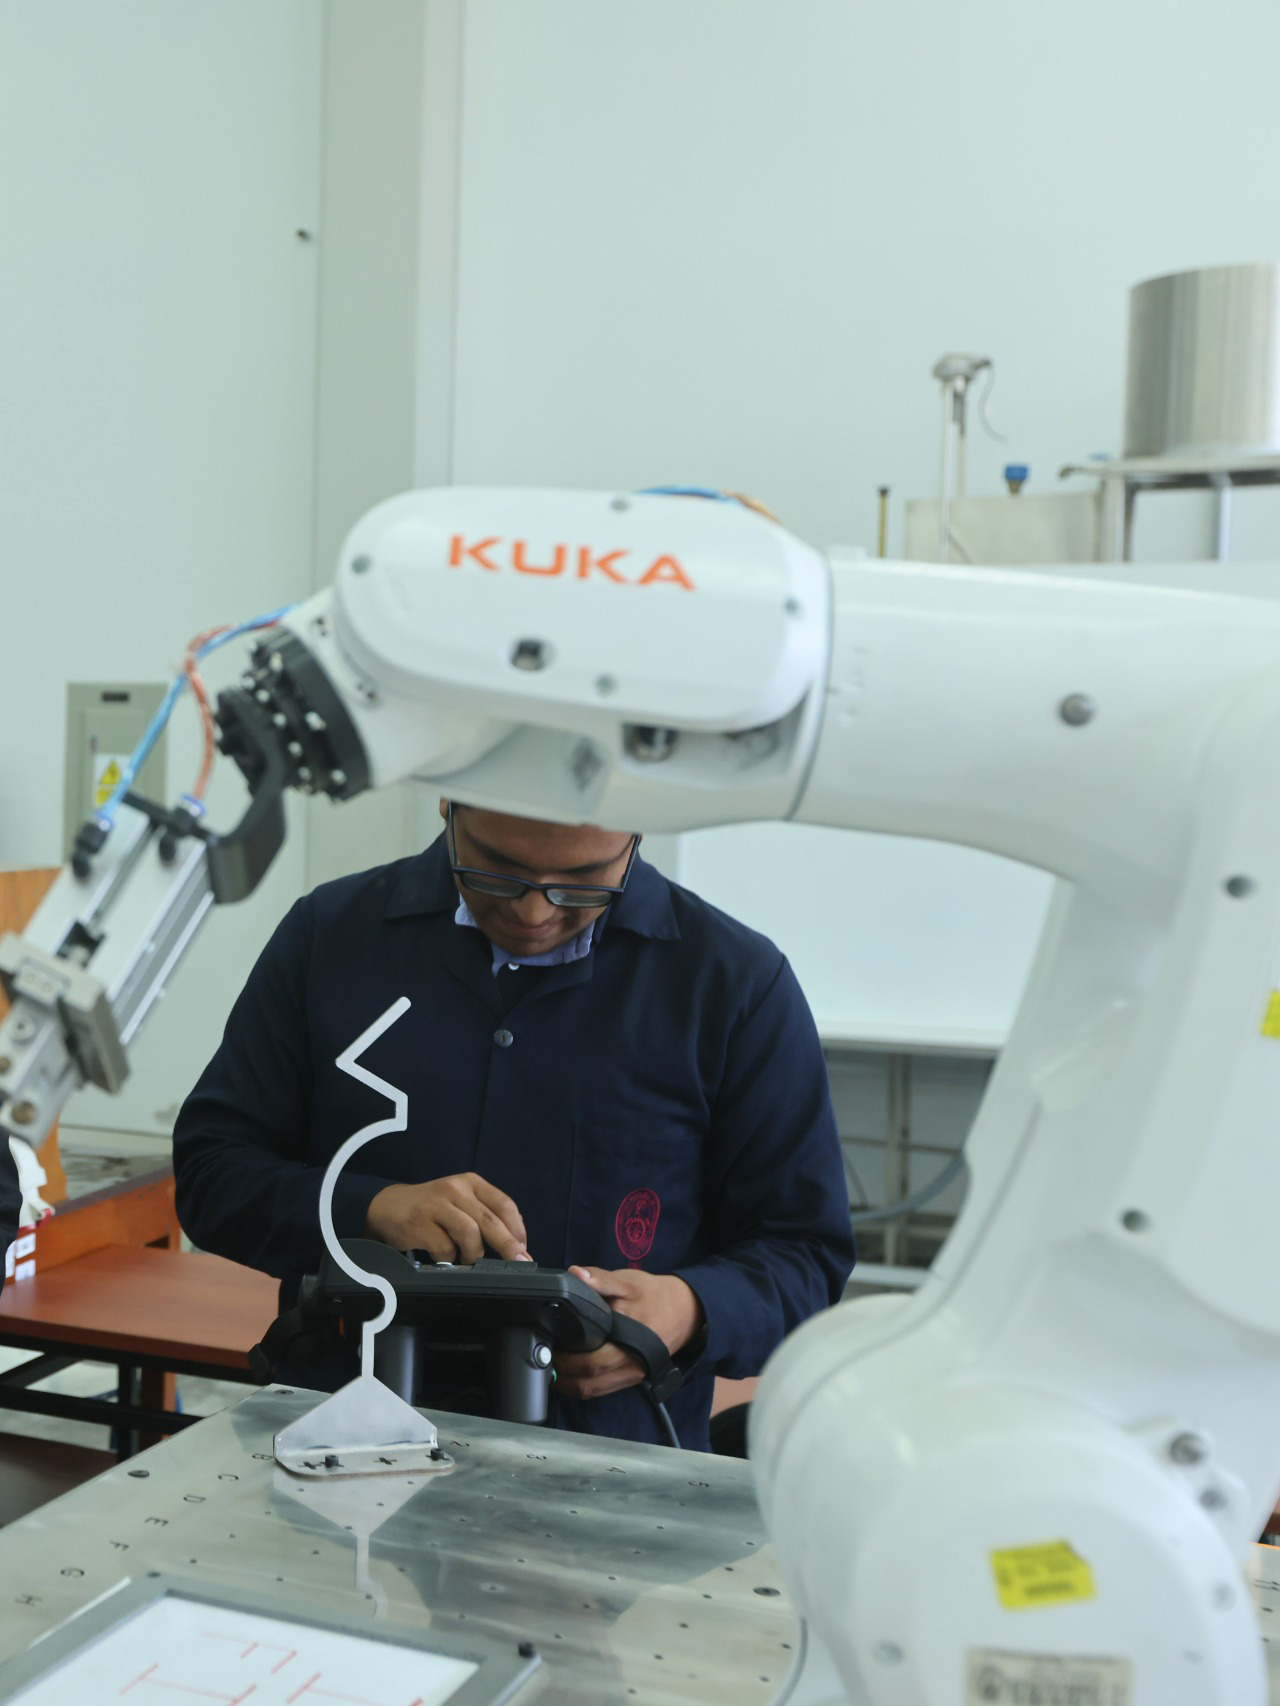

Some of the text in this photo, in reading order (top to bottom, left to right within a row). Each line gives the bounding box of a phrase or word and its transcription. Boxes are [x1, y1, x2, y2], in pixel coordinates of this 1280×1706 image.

[448, 533, 699, 592] KUKA
[144, 1516, 169, 1528] E
[110, 1540, 130, 1551] F
